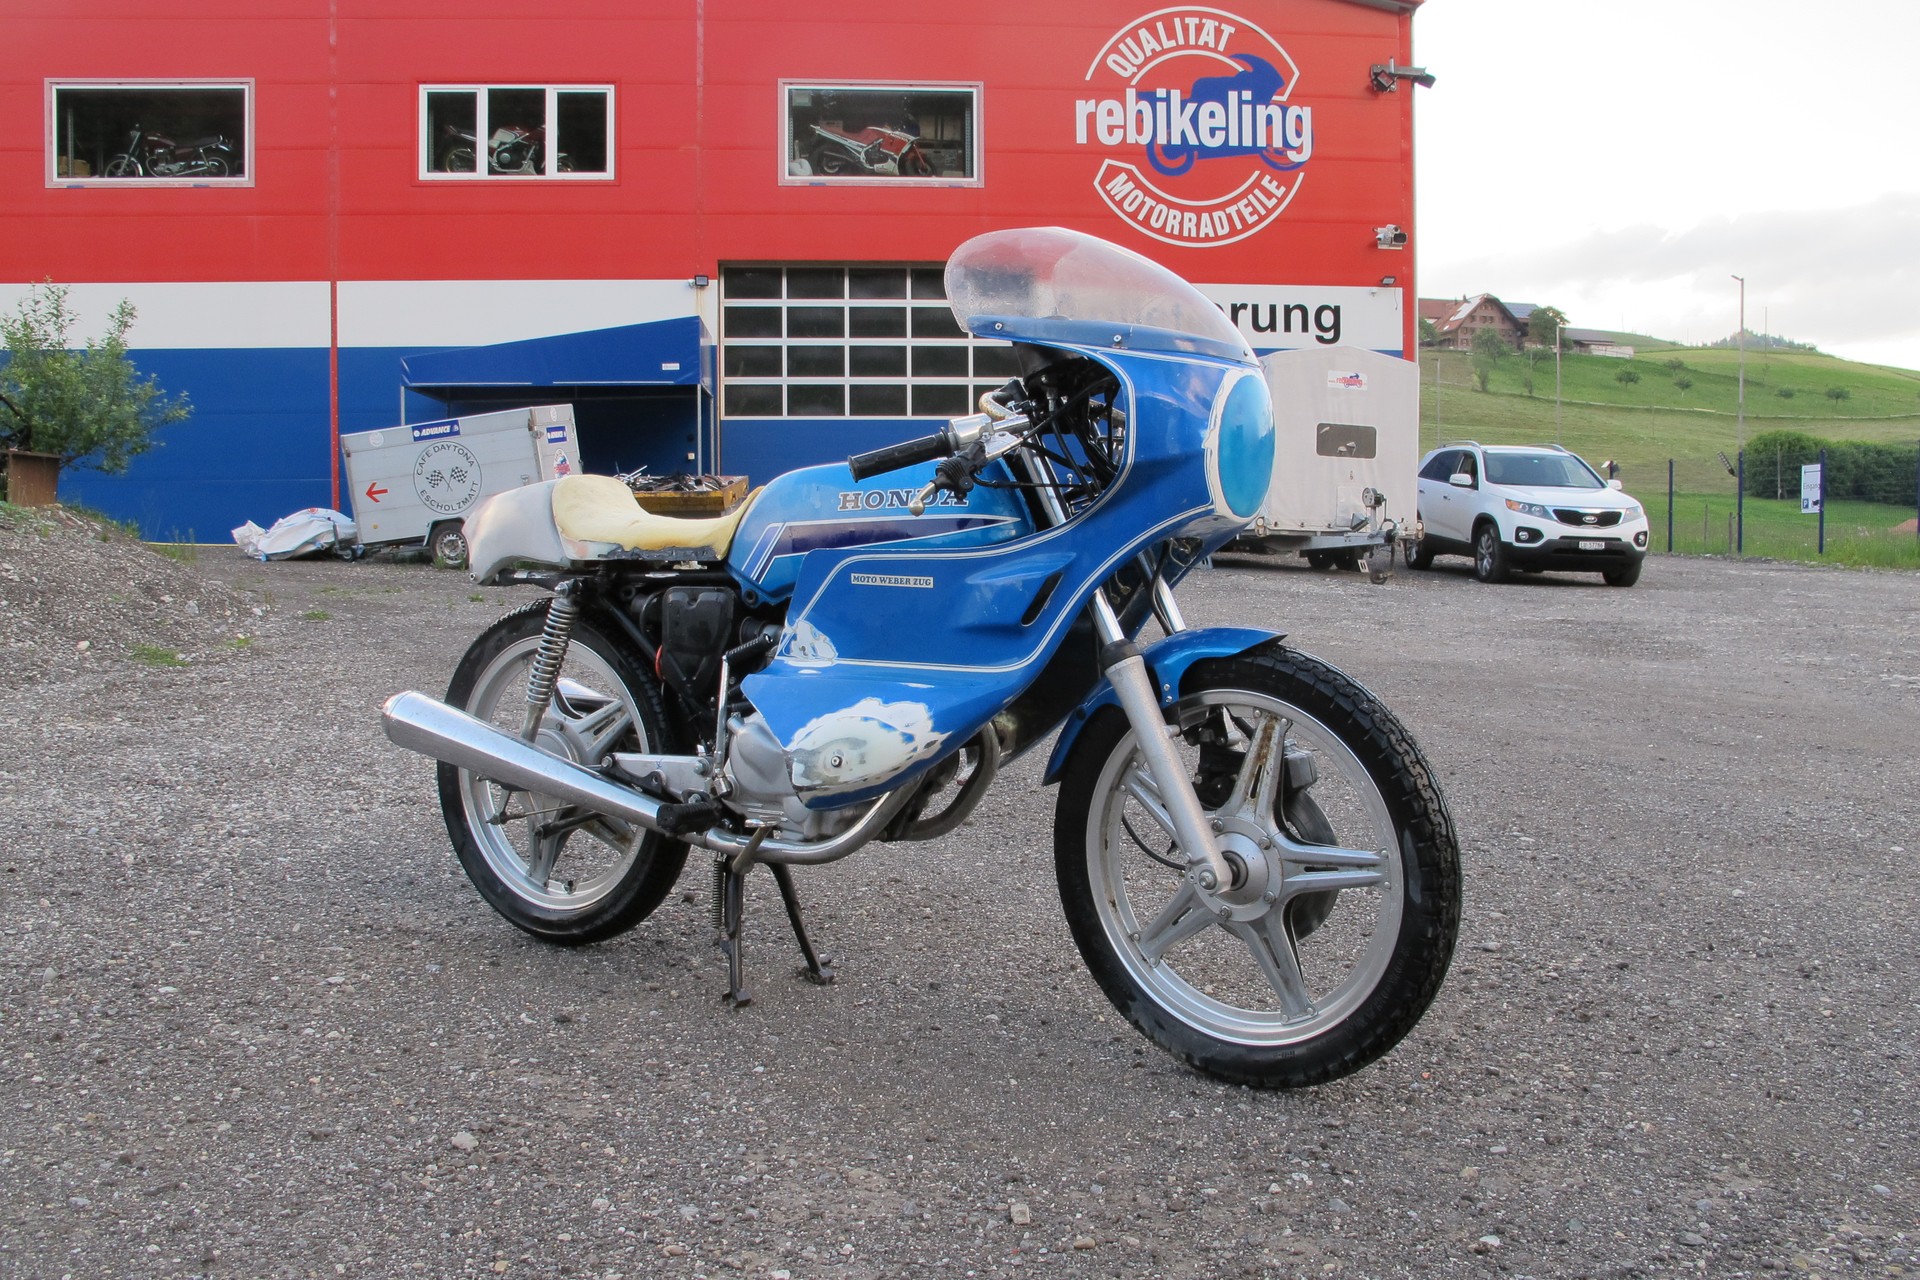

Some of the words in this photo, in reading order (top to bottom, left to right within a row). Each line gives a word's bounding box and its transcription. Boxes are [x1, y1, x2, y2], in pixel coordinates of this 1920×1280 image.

[1106, 17, 1236, 78] QUALITÄT
[1075, 87, 1312, 163] rebikeling
[1105, 172, 1286, 239] MOTORRADTEILE
[1214, 302, 1341, 345] rung
[421, 426, 451, 437] ADVANCE
[416, 450, 433, 476] CAFE
[433, 444, 475, 467] DAYTONA
[420, 481, 479, 512] ESCHOLZMATT
[852, 574, 877, 584] MOTO
[879, 576, 911, 585] WEBER
[913, 577, 932, 586] ZUG
